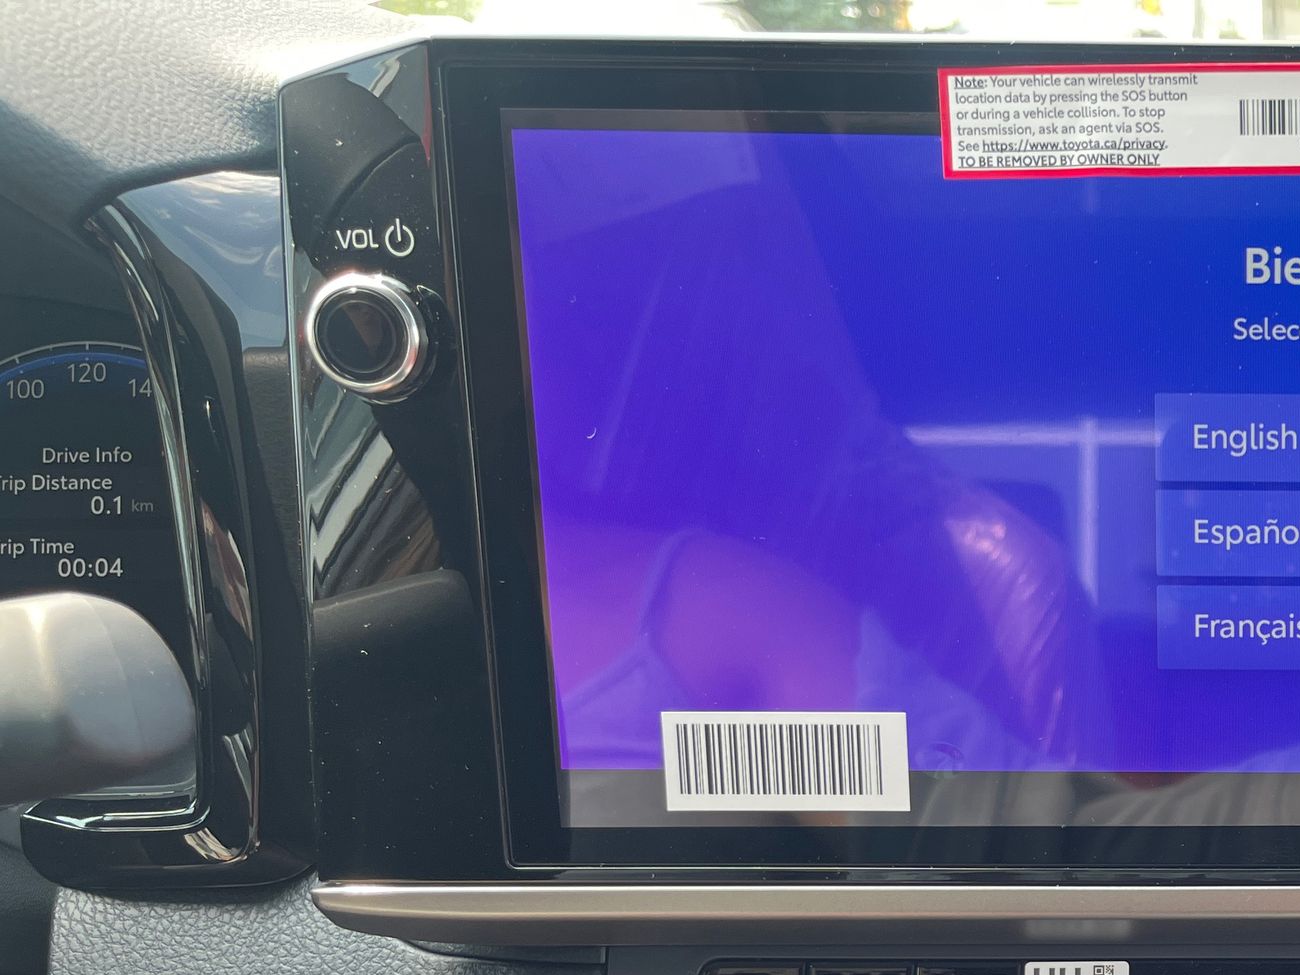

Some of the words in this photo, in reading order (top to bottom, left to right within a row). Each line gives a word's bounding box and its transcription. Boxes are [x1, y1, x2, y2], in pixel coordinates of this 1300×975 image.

[954, 77, 987, 89] Note:
[989, 76, 1017, 87] Your
[1019, 75, 1061, 87] vehicle
[1064, 76, 1085, 86] can
[1087, 74, 1145, 87] wirelessly
[1148, 73, 1198, 85] transmit
[955, 92, 1002, 104] location
[1004, 92, 1030, 103] data
[1033, 91, 1047, 105] by
[1050, 92, 1097, 105] pressing
[1100, 91, 1119, 101] the
[1121, 91, 1146, 101] SOS
[1148, 91, 1187, 101] button
[956, 110, 968, 120] or
[971, 108, 1010, 121] during
[1013, 109, 1020, 119] a
[1023, 107, 1064, 119] vehicle
[1067, 106, 1120, 118] collision.
[1123, 107, 1137, 117] To
[1139, 107, 1165, 119] stop
[957, 124, 1036, 136] transmission,
[1038, 124, 1058, 134] ask
[1061, 125, 1075, 134] an
[1078, 124, 1113, 136] agent
[1115, 122, 1132, 133] via
[1135, 122, 1164, 133] SOS.
[958, 141, 980, 151] See
[982, 138, 1168, 153] https://www.toyota.ca/privacy.
[959, 156, 975, 168] TO
[979, 156, 993, 168] BE
[997, 155, 1057, 167] REMOVED
[1061, 155, 1075, 166] BY
[1077, 154, 1124, 166] OWNER
[1127, 154, 1160, 165] ONLY
[336, 230, 379, 249] VOL
[68, 362, 106, 383] 120
[6, 379, 44, 399] 100
[128, 378, 152, 398] 14
[1193, 423, 1298, 457] English
[42, 448, 90, 464] Drive
[95, 447, 132, 464] Info
[0, 476, 27, 495] rip
[32, 475, 113, 491] Distance
[91, 495, 123, 516] 0.1
[132, 500, 154, 513] km
[0, 538, 25, 558] rip
[30, 538, 75, 555] Time
[58, 557, 123, 578] 00:04
